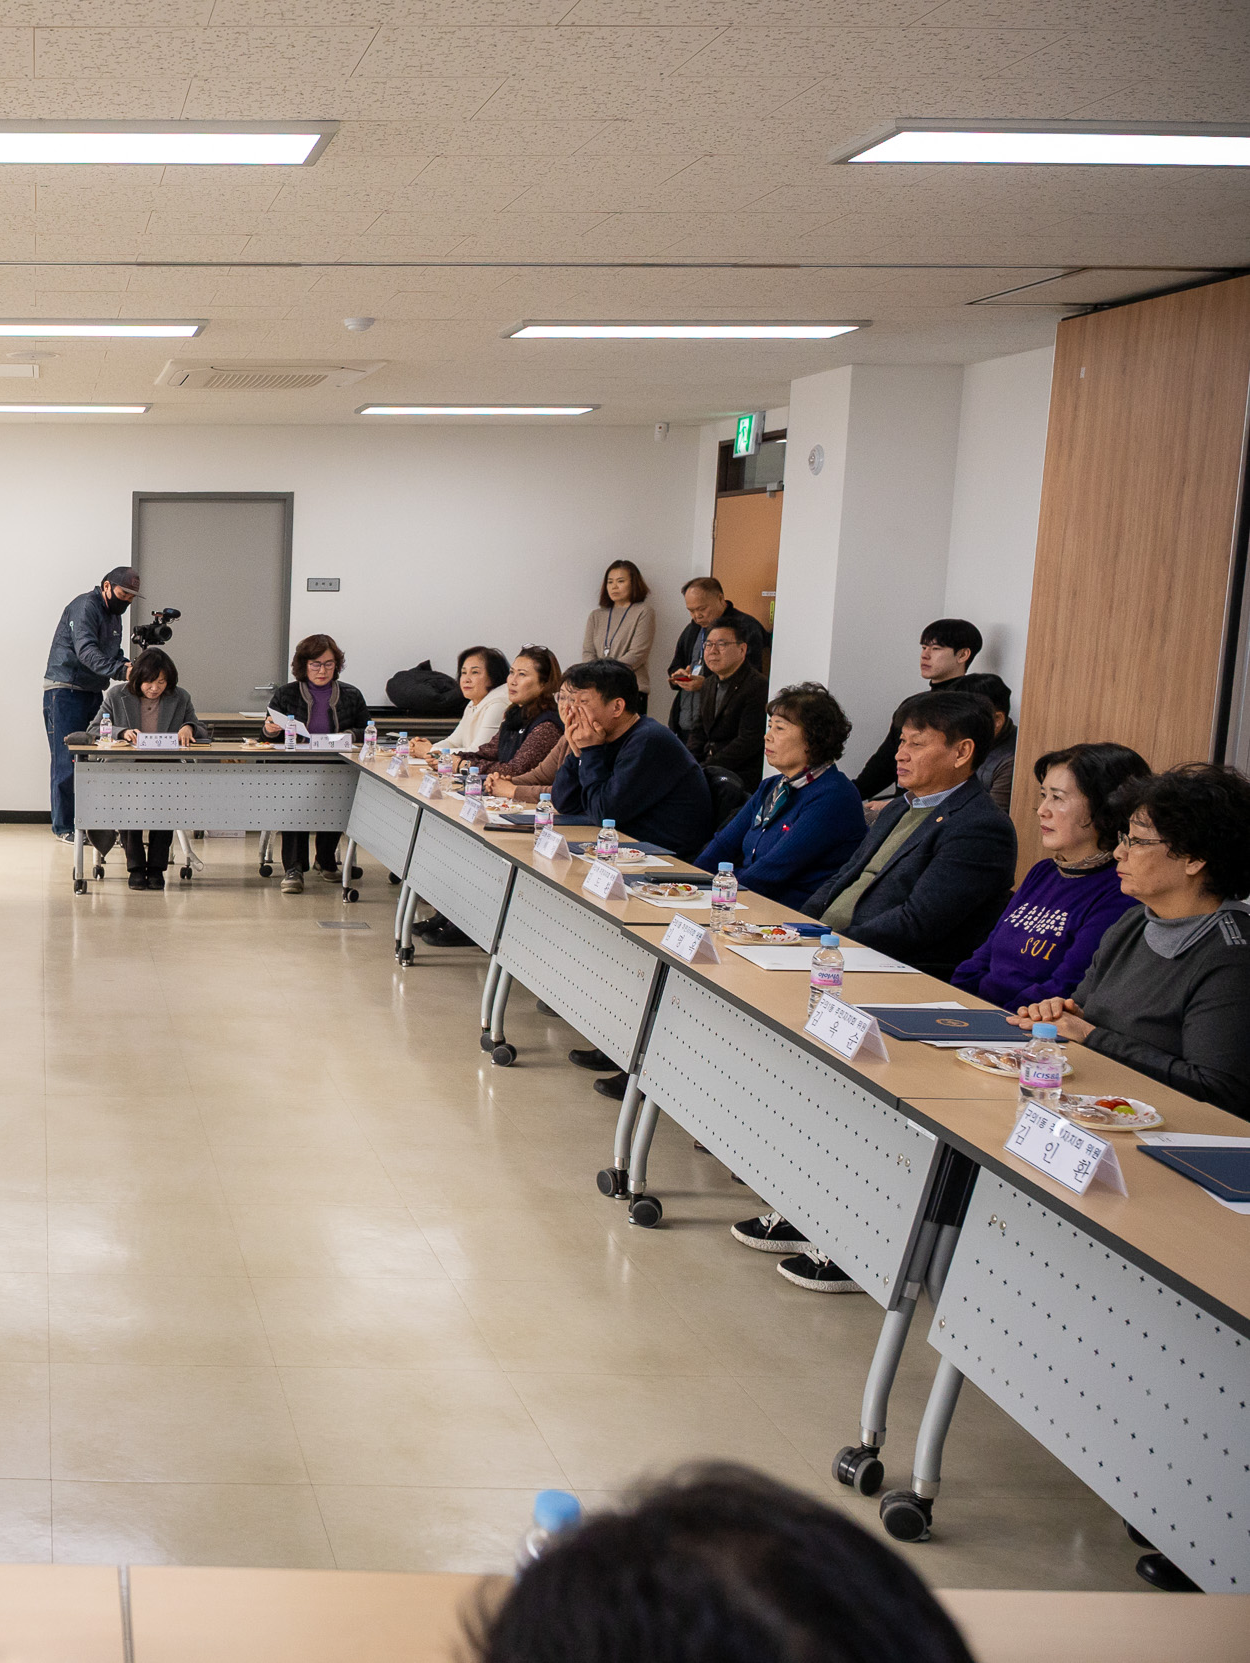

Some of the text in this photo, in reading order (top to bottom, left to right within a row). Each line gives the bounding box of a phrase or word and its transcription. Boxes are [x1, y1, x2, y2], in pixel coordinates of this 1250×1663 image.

[1020, 936, 1057, 961] SUI
[856, 1020, 868, 1033] 위원
[1025, 1108, 1048, 1129] 구의1동
[1085, 1143, 1102, 1160] 위원
